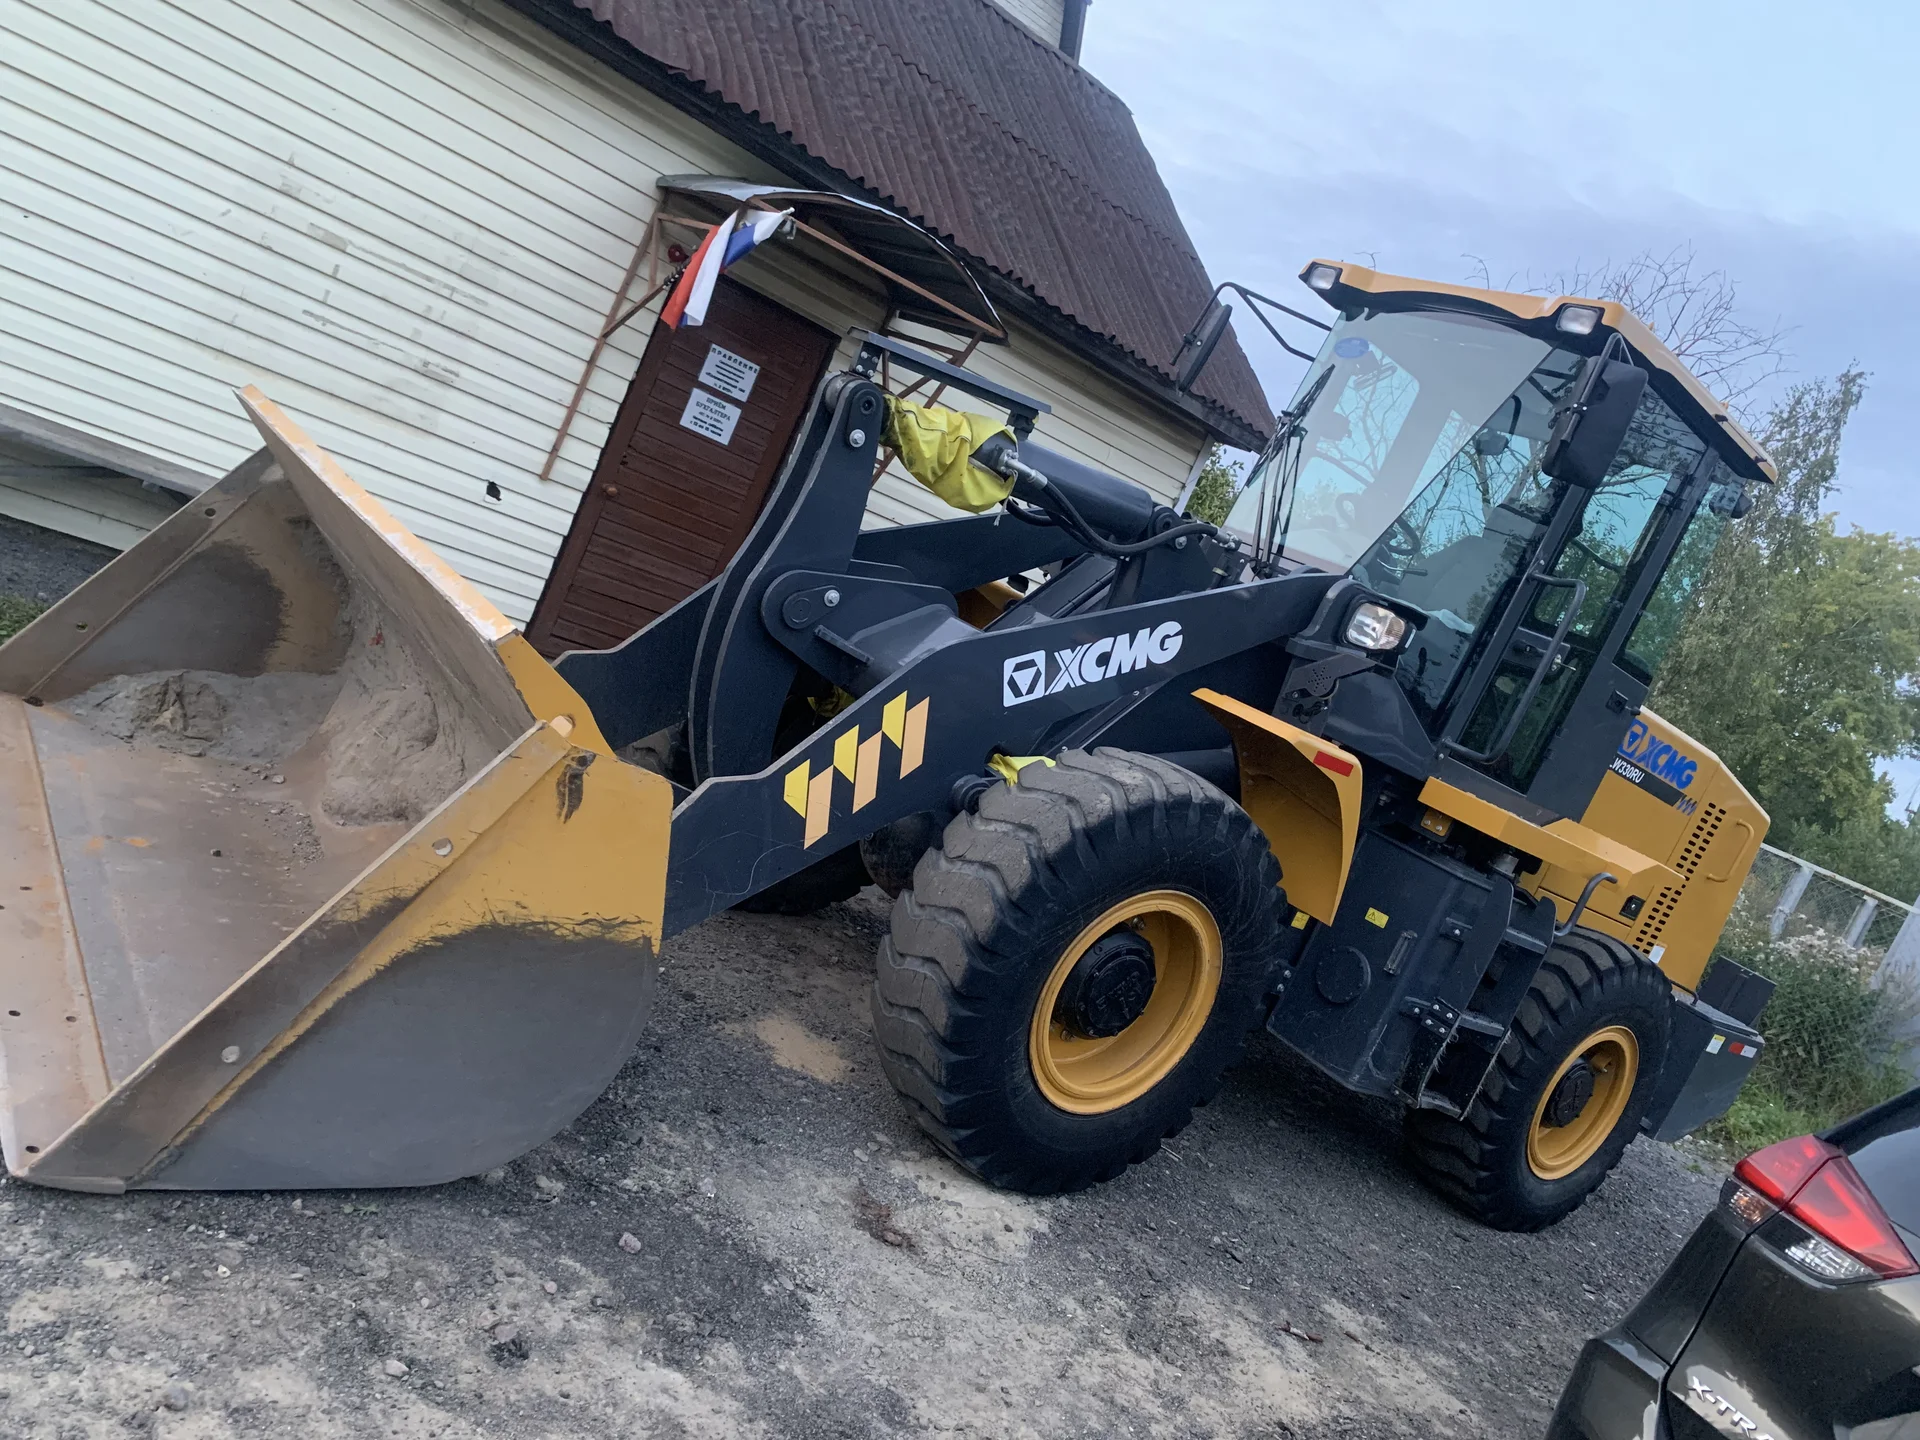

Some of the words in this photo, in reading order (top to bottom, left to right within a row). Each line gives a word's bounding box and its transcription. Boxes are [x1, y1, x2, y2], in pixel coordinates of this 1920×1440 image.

[711, 347, 757, 373] ПРАВЛЕНИЕ
[696, 401, 731, 421] БУХГАЛТЕРА
[706, 397, 726, 410] ПРИЁМ
[1044, 621, 1183, 695] XCMG
[1609, 758, 1645, 783] W330RU
[1635, 734, 1698, 789] XCMG
